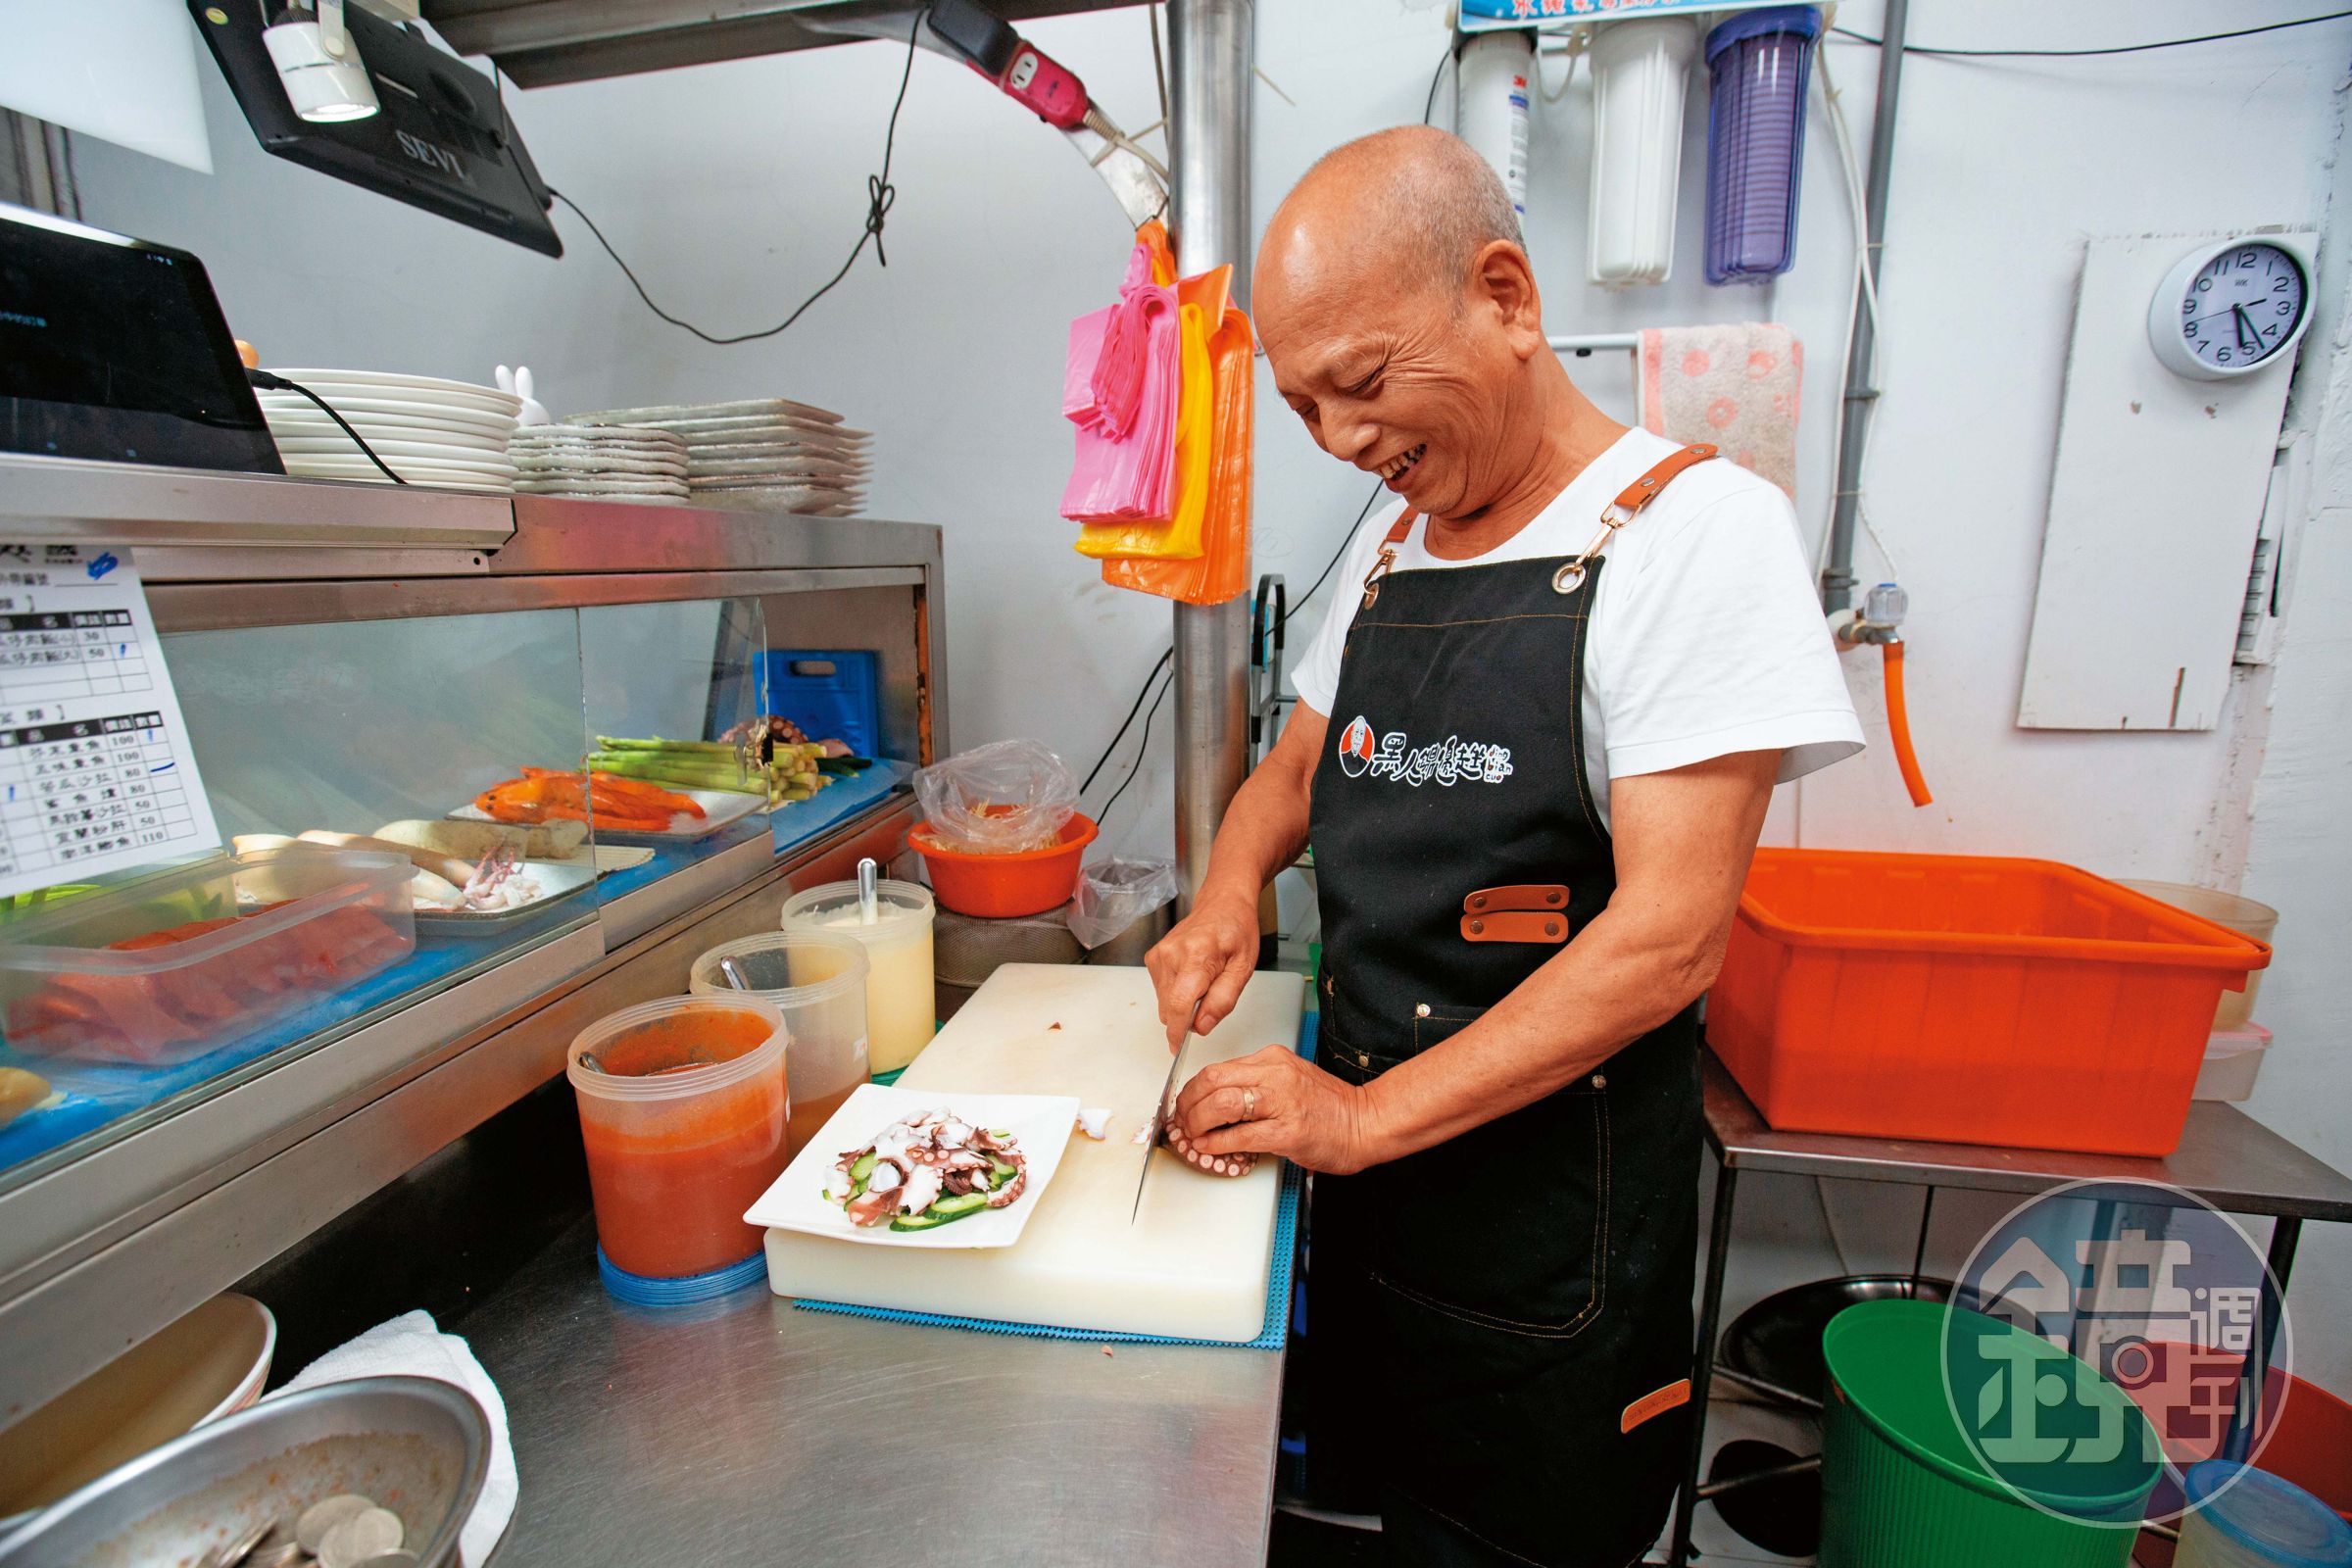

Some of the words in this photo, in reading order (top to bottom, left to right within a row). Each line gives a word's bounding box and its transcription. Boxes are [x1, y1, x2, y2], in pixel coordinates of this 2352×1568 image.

[2213, 260, 2230, 275] 11
[2235, 251, 2257, 269] 12
[2191, 276, 2213, 293] 10
[2273, 276, 2289, 292] 2
[2183, 299, 2197, 315] 9
[2276, 301, 2291, 316] 3
[2183, 321, 2198, 337] 8
[2261, 323, 2278, 337] 4
[2197, 340, 2210, 354] 7
[2217, 346, 2231, 362] 6
[2241, 341, 2257, 356] 5
